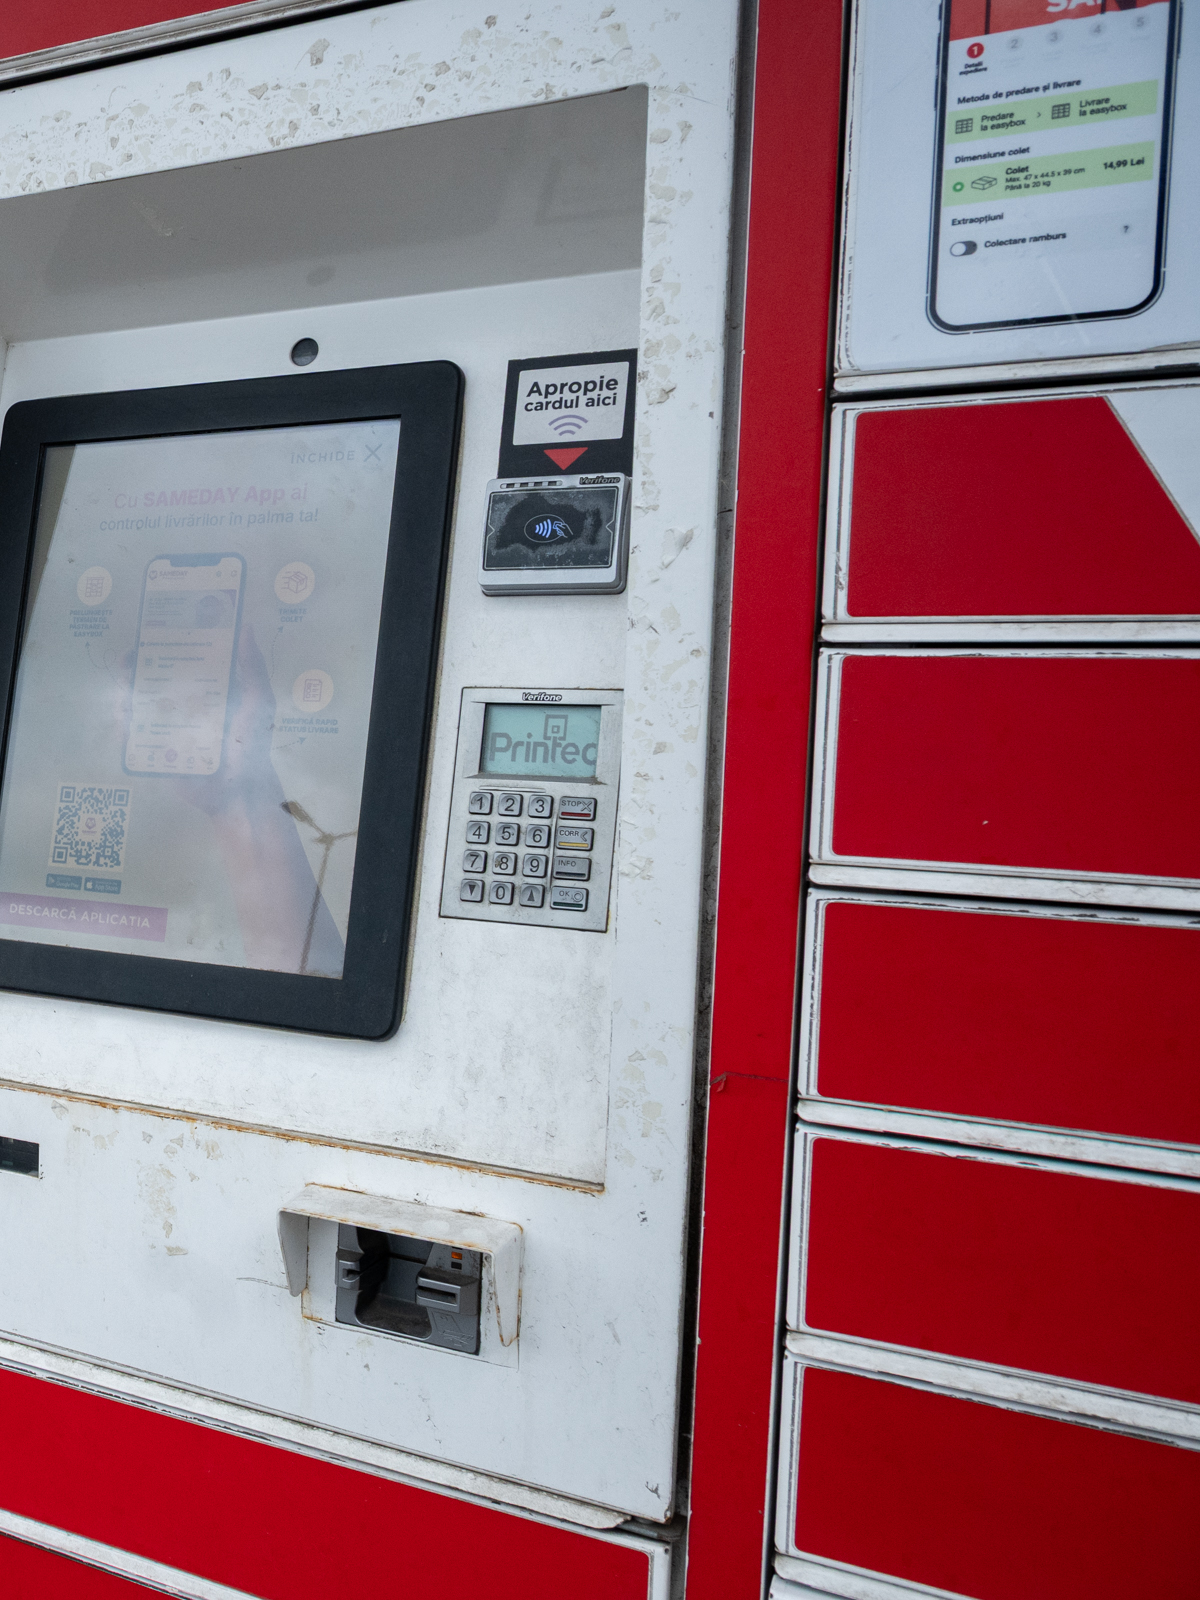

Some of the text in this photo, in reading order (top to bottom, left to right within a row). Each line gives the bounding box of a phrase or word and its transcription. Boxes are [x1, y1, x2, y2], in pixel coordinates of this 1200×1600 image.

[957, 93, 990, 104] Metoda
[992, 91, 1003, 99] de
[1005, 85, 1040, 98] predare
[1052, 79, 1081, 89] livrare
[1079, 98, 1110, 108] Livrare
[1089, 104, 1127, 115] easybox
[981, 112, 1015, 122] Predare
[990, 119, 1026, 130] easybox
[955, 146, 1030, 163] Dimensiune colet
[1005, 166, 1029, 175] Colet
[1103, 157, 1145, 170] 14,99 Lei
[1043, 180, 1051, 188] kg
[984, 233, 1067, 248] Colectare ramburs
[526, 376, 619, 399] Apropie
[524, 393, 617, 412] cardul aici
[290, 450, 356, 464] ÎNCHIDE
[579, 476, 621, 485] Verifone
[114, 483, 308, 509] Cu SAMEDAY App ai
[100, 508, 320, 532] controlul livrărilor în palma ta!
[280, 615, 304, 623] COLET
[522, 692, 562, 702] Verifone
[315, 718, 339, 726] RAPID
[308, 726, 339, 734] LIVRARE
[488, 732, 597, 766] Printec
[476, 796, 582, 813] 1 2 3 STOP
[472, 826, 580, 843] 4 5 6 CORR
[469, 854, 577, 873] 7 8 9 INFO
[496, 886, 570, 900] 0 OK
[9, 903, 77, 920] DESCARCĂ
